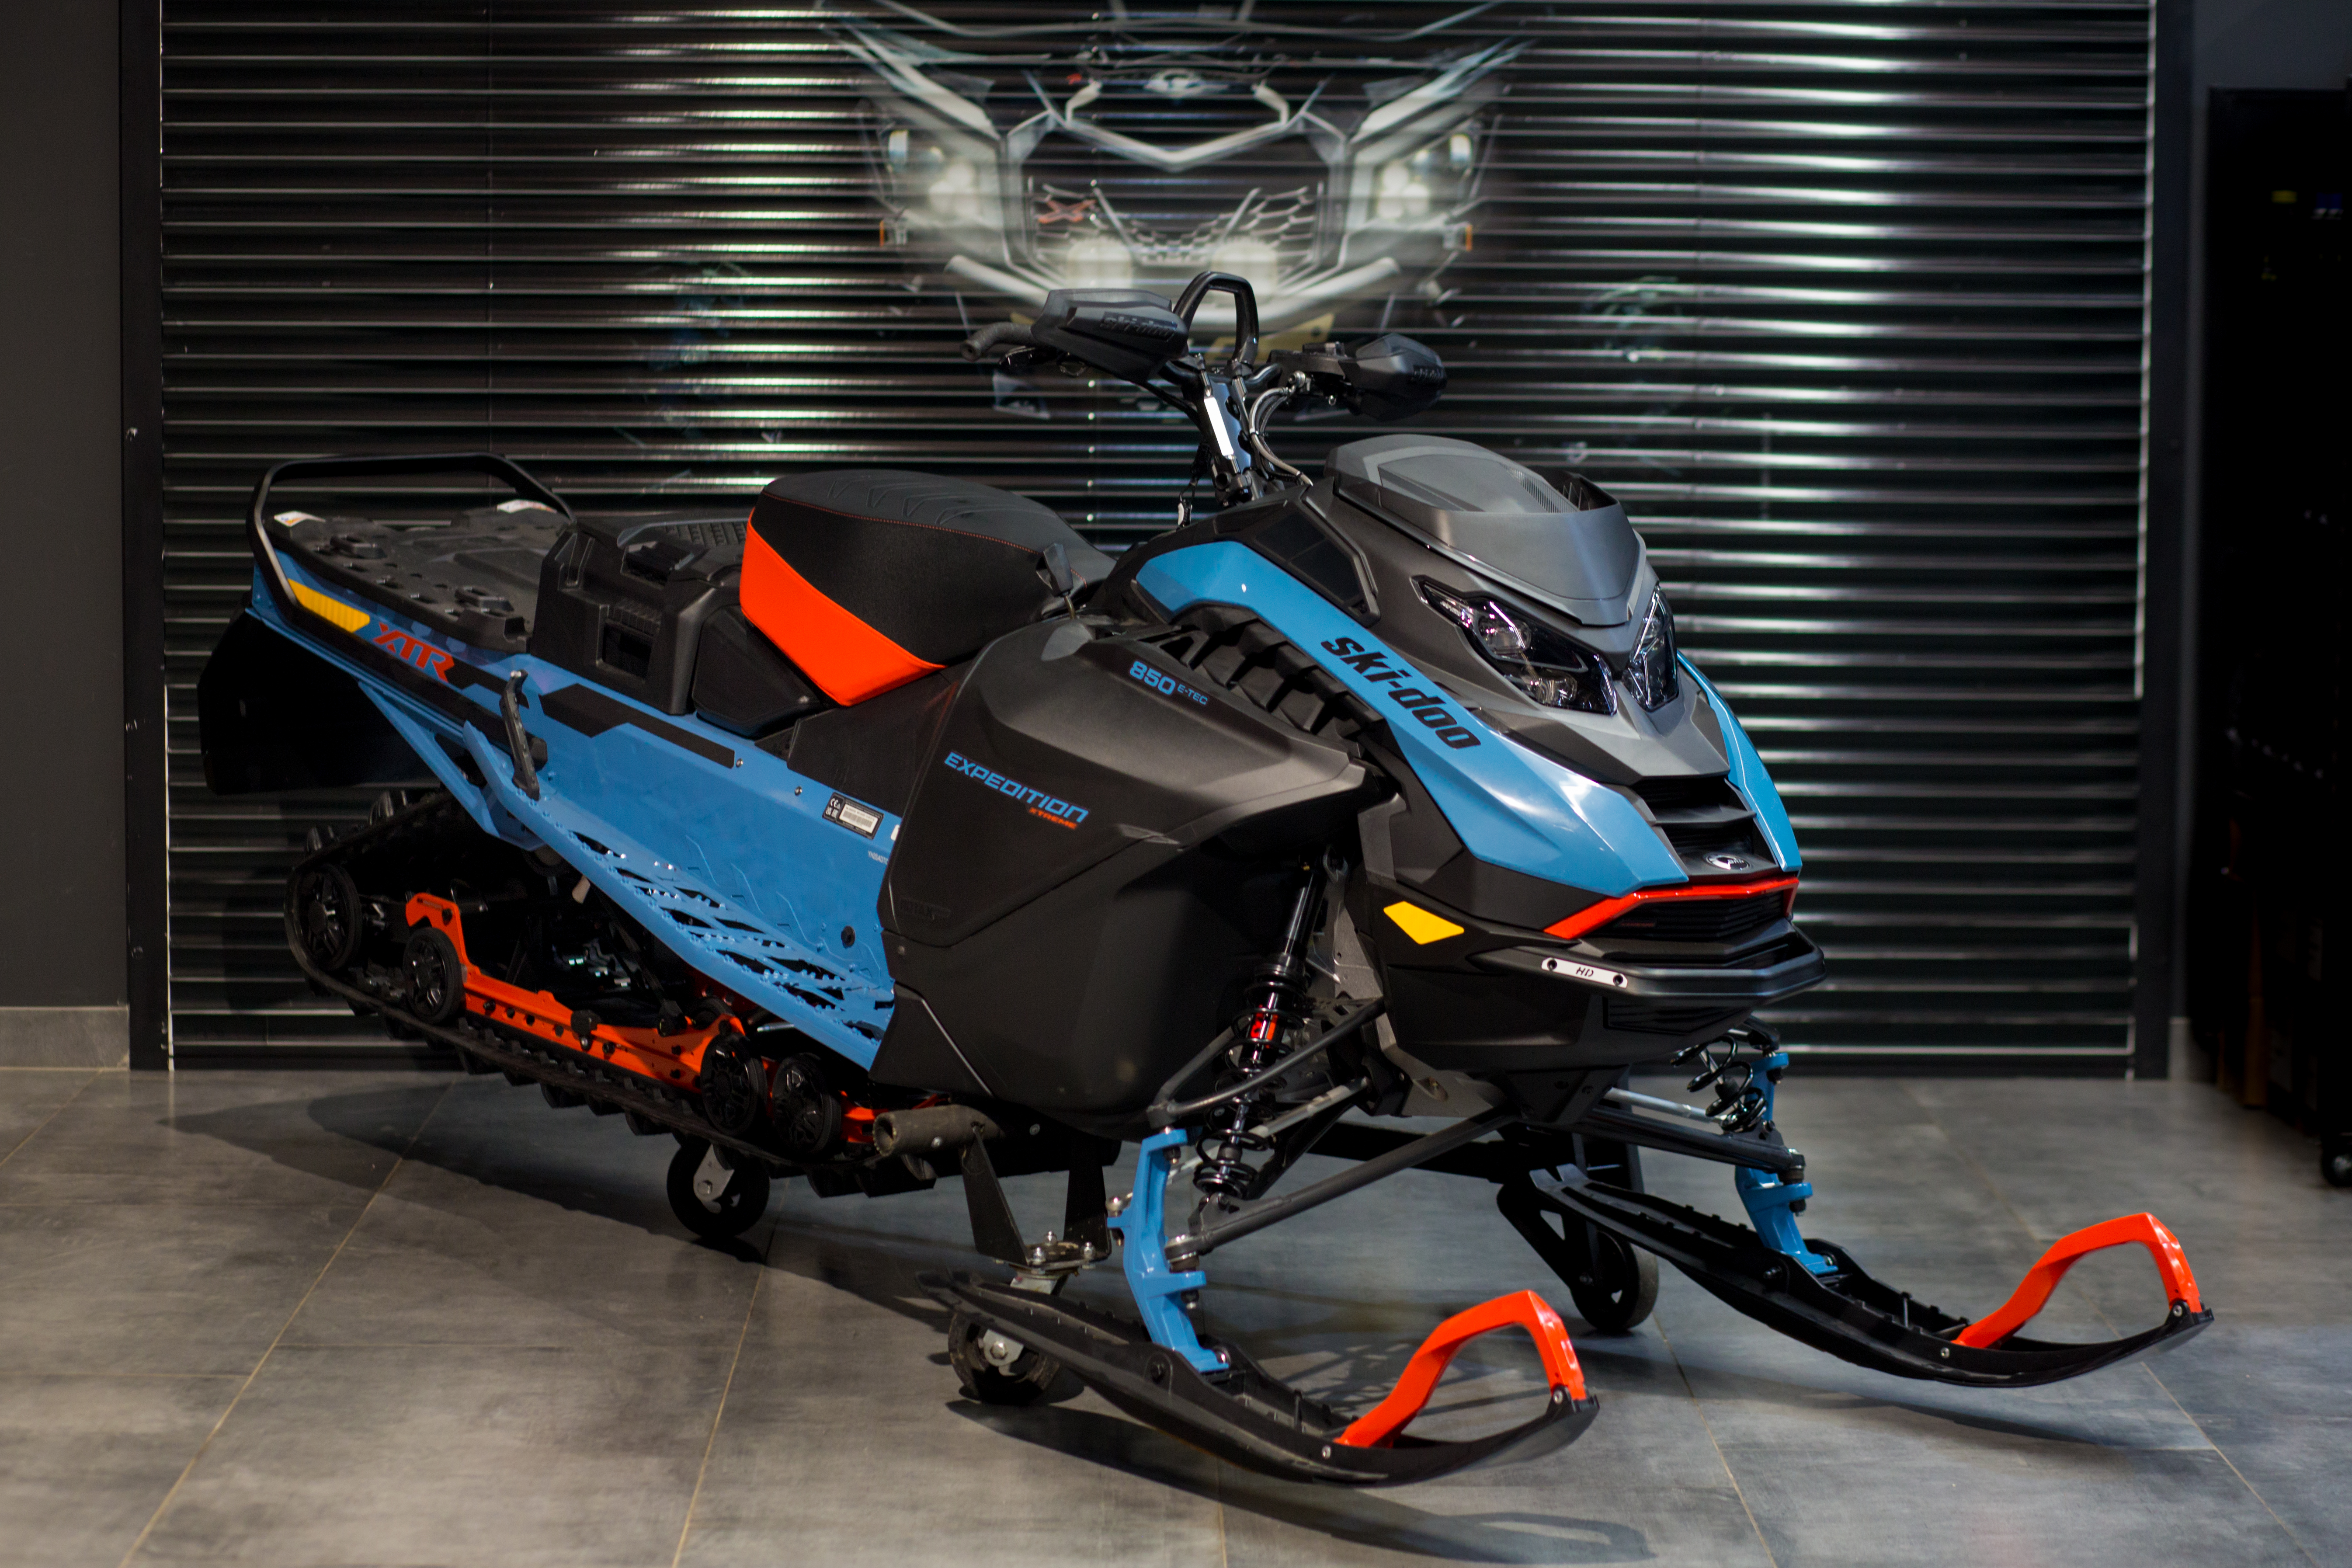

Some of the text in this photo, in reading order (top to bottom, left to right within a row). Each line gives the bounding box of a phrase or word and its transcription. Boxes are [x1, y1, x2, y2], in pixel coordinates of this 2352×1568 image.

[373, 621, 455, 683] XTR
[1129, 661, 1208, 705] 850 E-TEC
[1320, 637, 1481, 749] ski-doo
[944, 751, 1089, 823] EXPEDITION
[1576, 967, 1594, 977] HD
